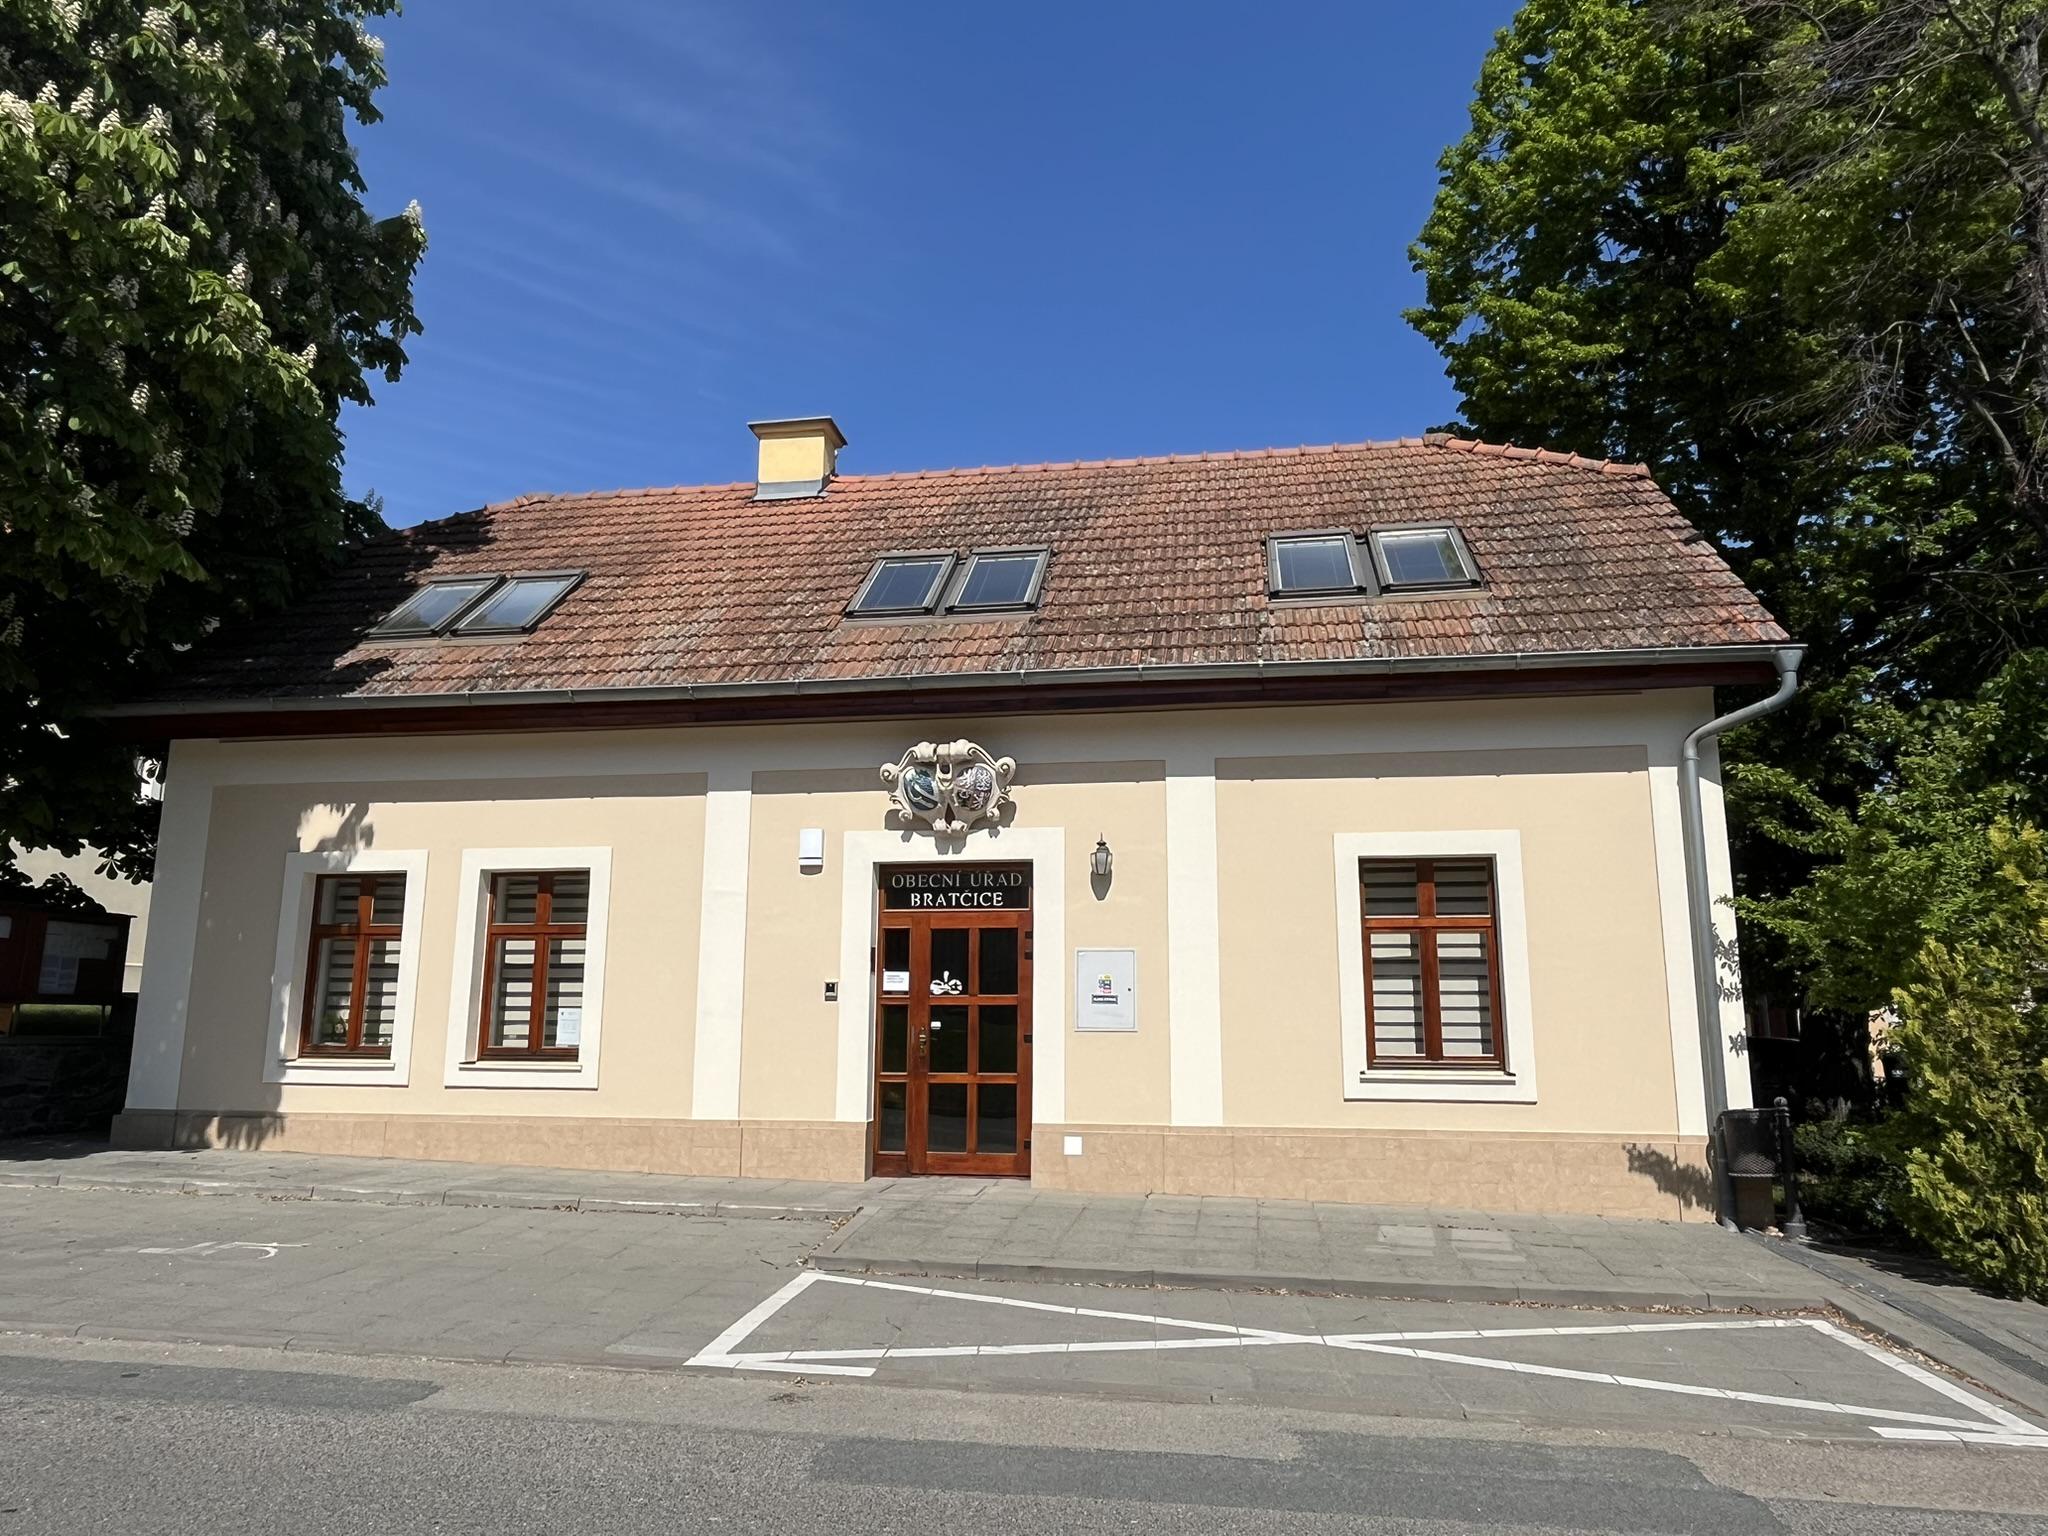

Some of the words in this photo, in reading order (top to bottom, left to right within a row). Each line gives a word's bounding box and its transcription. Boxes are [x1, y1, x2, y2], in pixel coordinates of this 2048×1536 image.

[892, 870, 962, 888] OBECNÍ
[970, 870, 1022, 887] ÚŘAD
[910, 890, 1004, 907] BRATČICE
